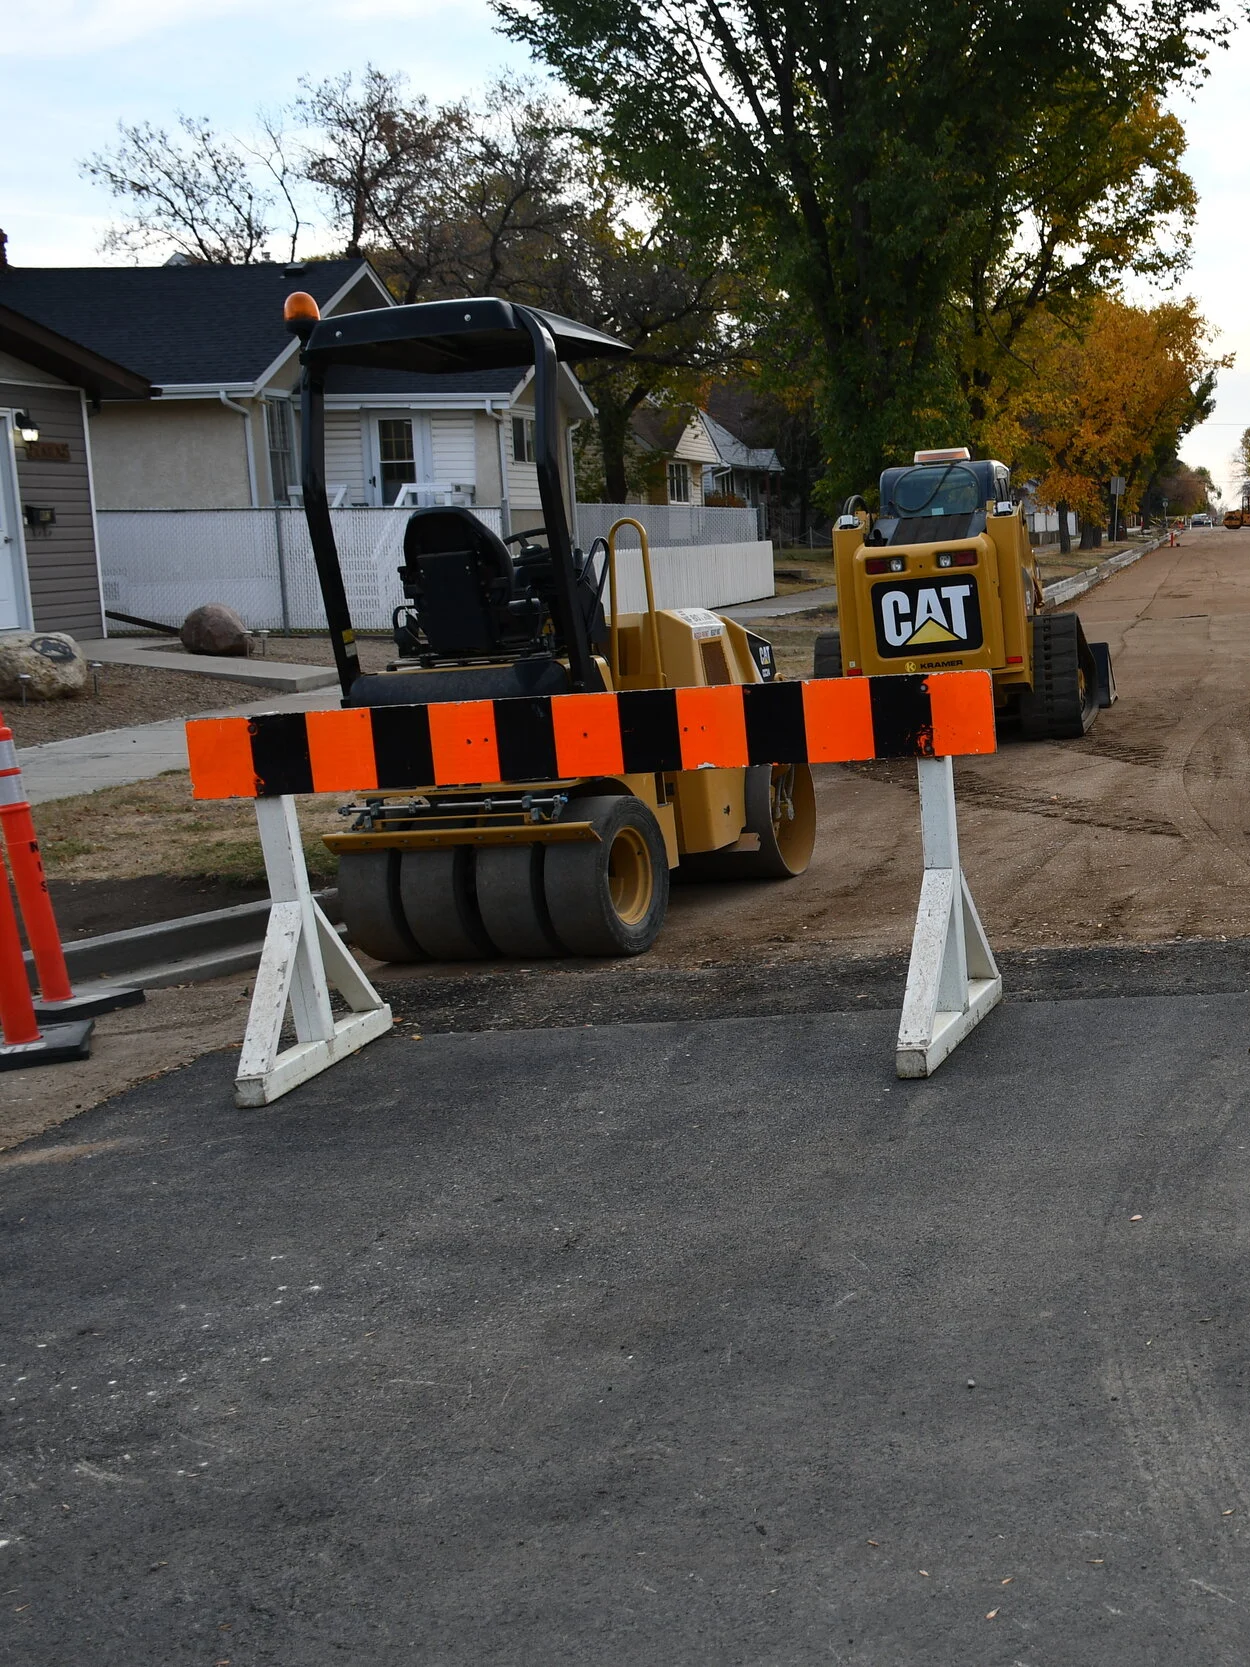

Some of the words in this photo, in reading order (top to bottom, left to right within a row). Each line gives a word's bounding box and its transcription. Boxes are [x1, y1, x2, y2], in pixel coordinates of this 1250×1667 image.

[881, 584, 971, 647] CAT
[759, 646, 771, 665] CAT
[920, 659, 964, 669] KRAMER
